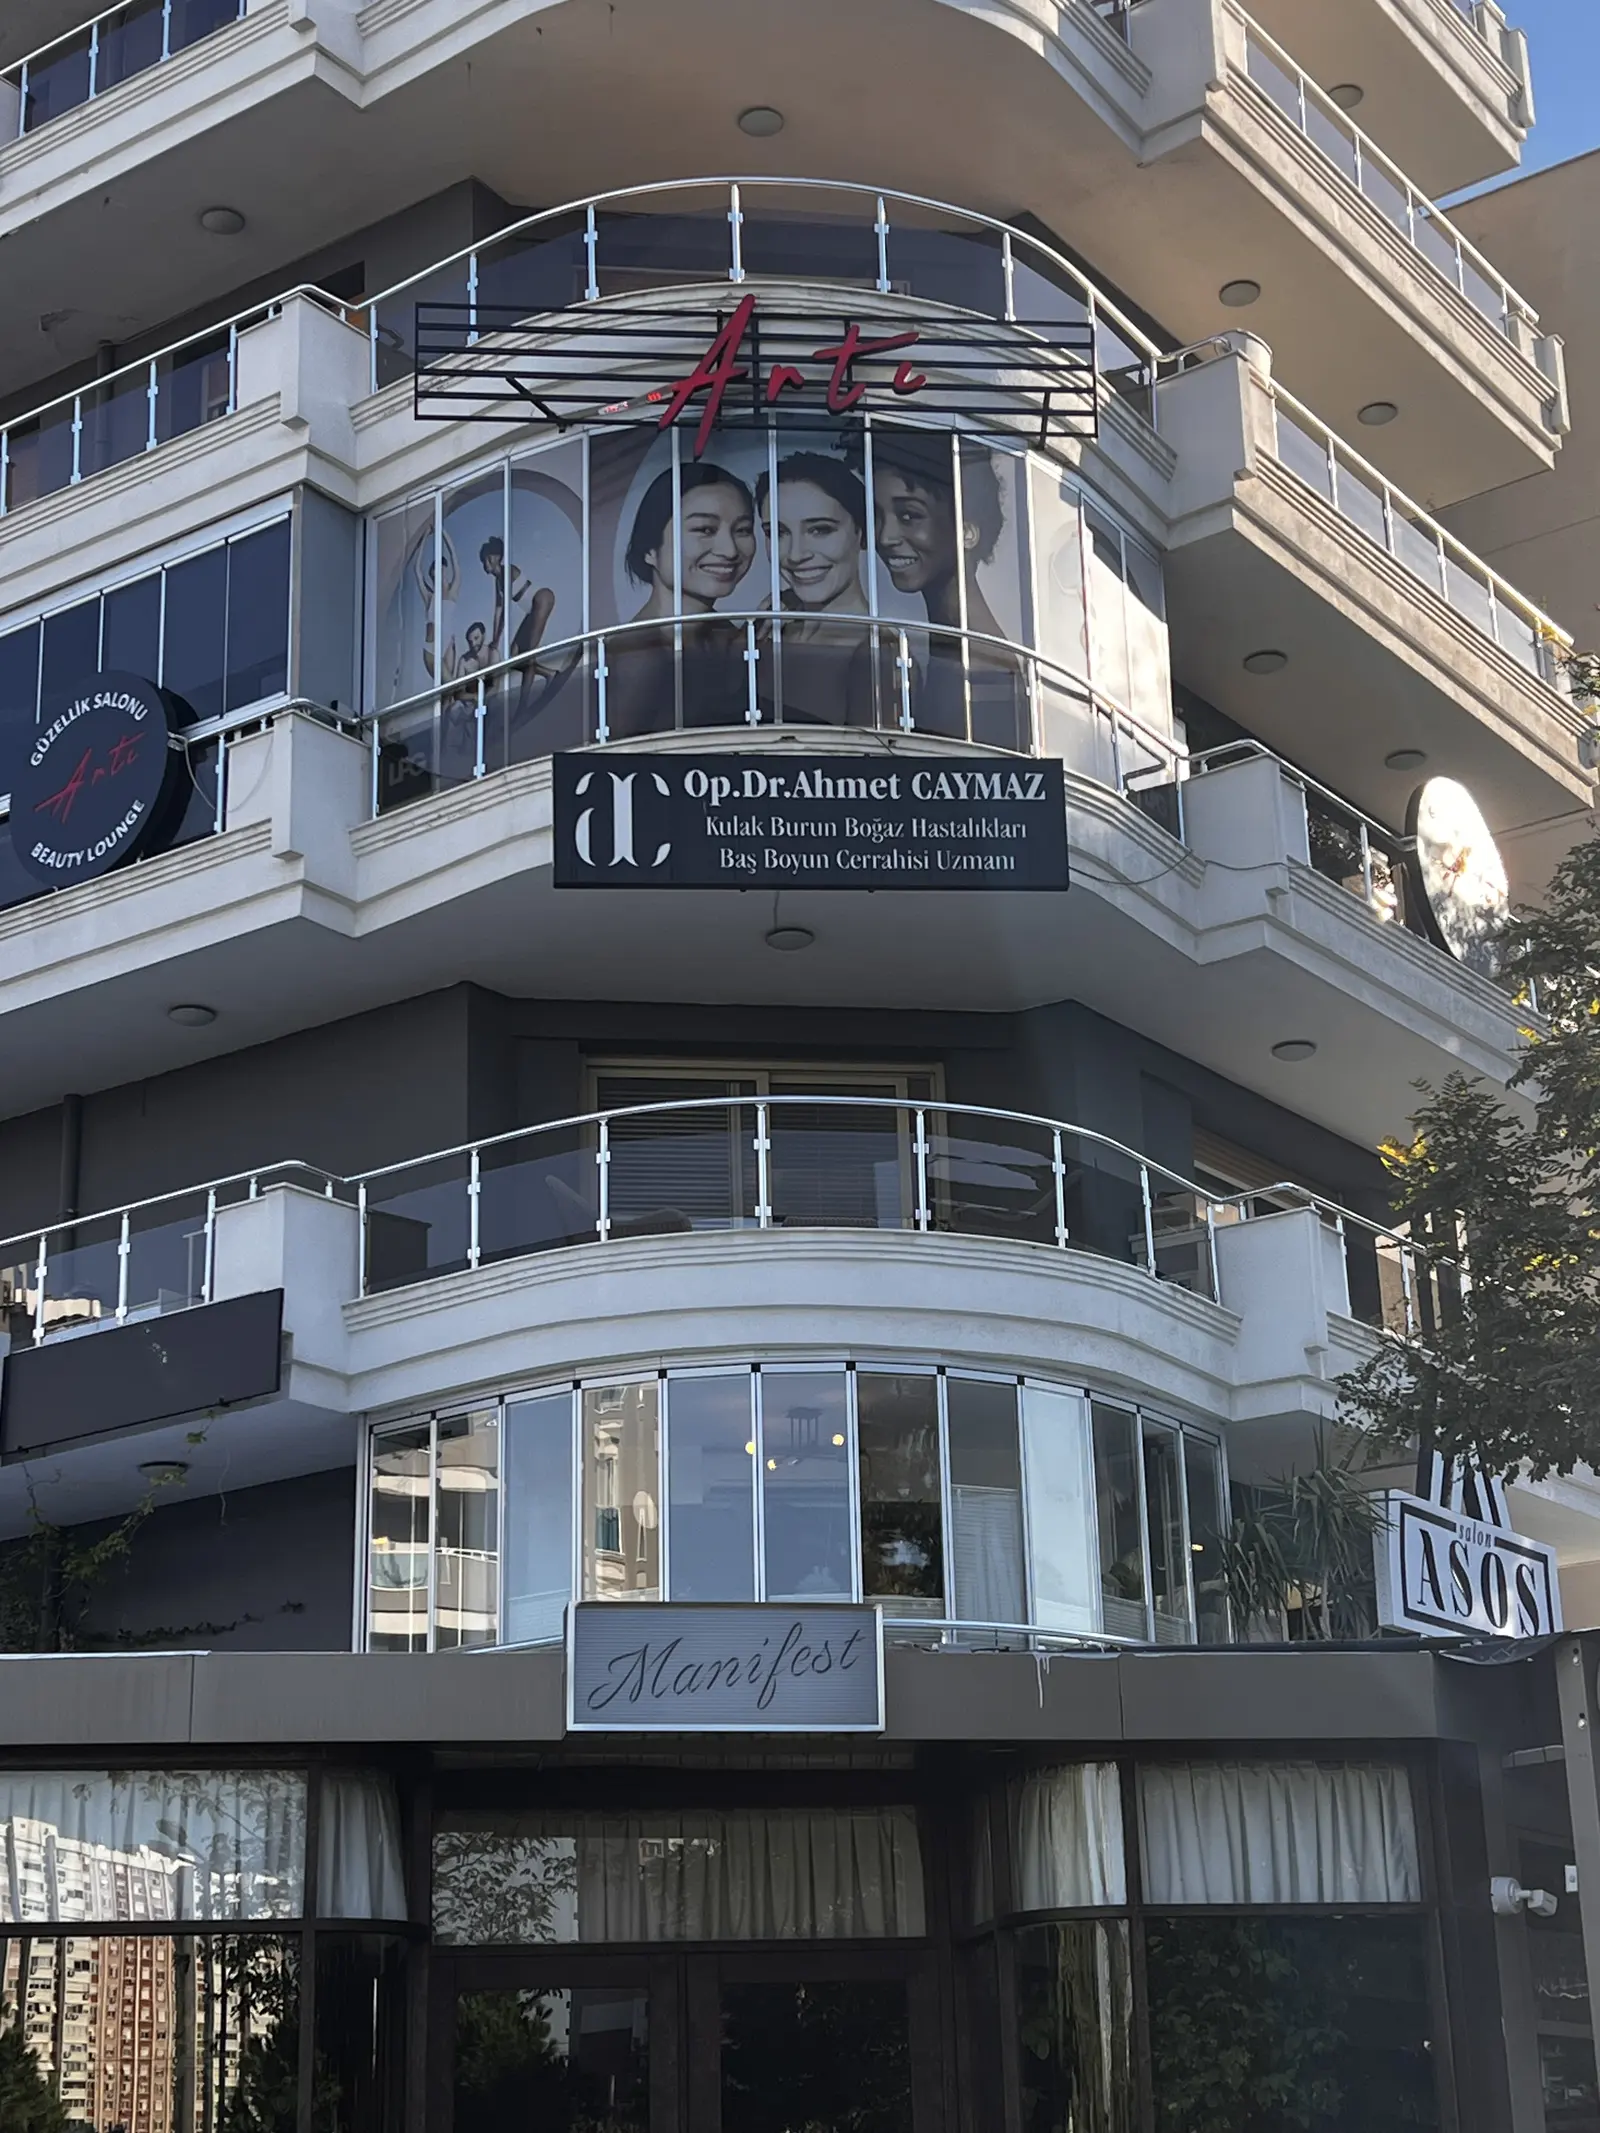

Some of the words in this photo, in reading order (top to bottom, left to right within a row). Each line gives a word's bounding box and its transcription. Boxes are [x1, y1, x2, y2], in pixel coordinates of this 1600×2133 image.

[93, 692, 148, 721] SALONU
[684, 769, 902, 806] Op.Dr.Ahmet
[911, 771, 1046, 801] CAYMAZ
[30, 842, 85, 868] BEAUTY
[87, 800, 145, 862] LOUNGE
[706, 815, 765, 836] Kulak
[771, 816, 837, 837] Burun
[845, 816, 904, 844] Boğaz
[911, 817, 1027, 838] Hastalıkları
[720, 848, 757, 874] Baş
[764, 848, 830, 875] Boyun
[836, 849, 929, 870] Cerrahisi
[936, 850, 1016, 870] Uzmanı
[1458, 1521, 1492, 1549] salon
[1416, 1528, 1540, 1638] ASOS
[587, 1622, 867, 1711] Manifest
